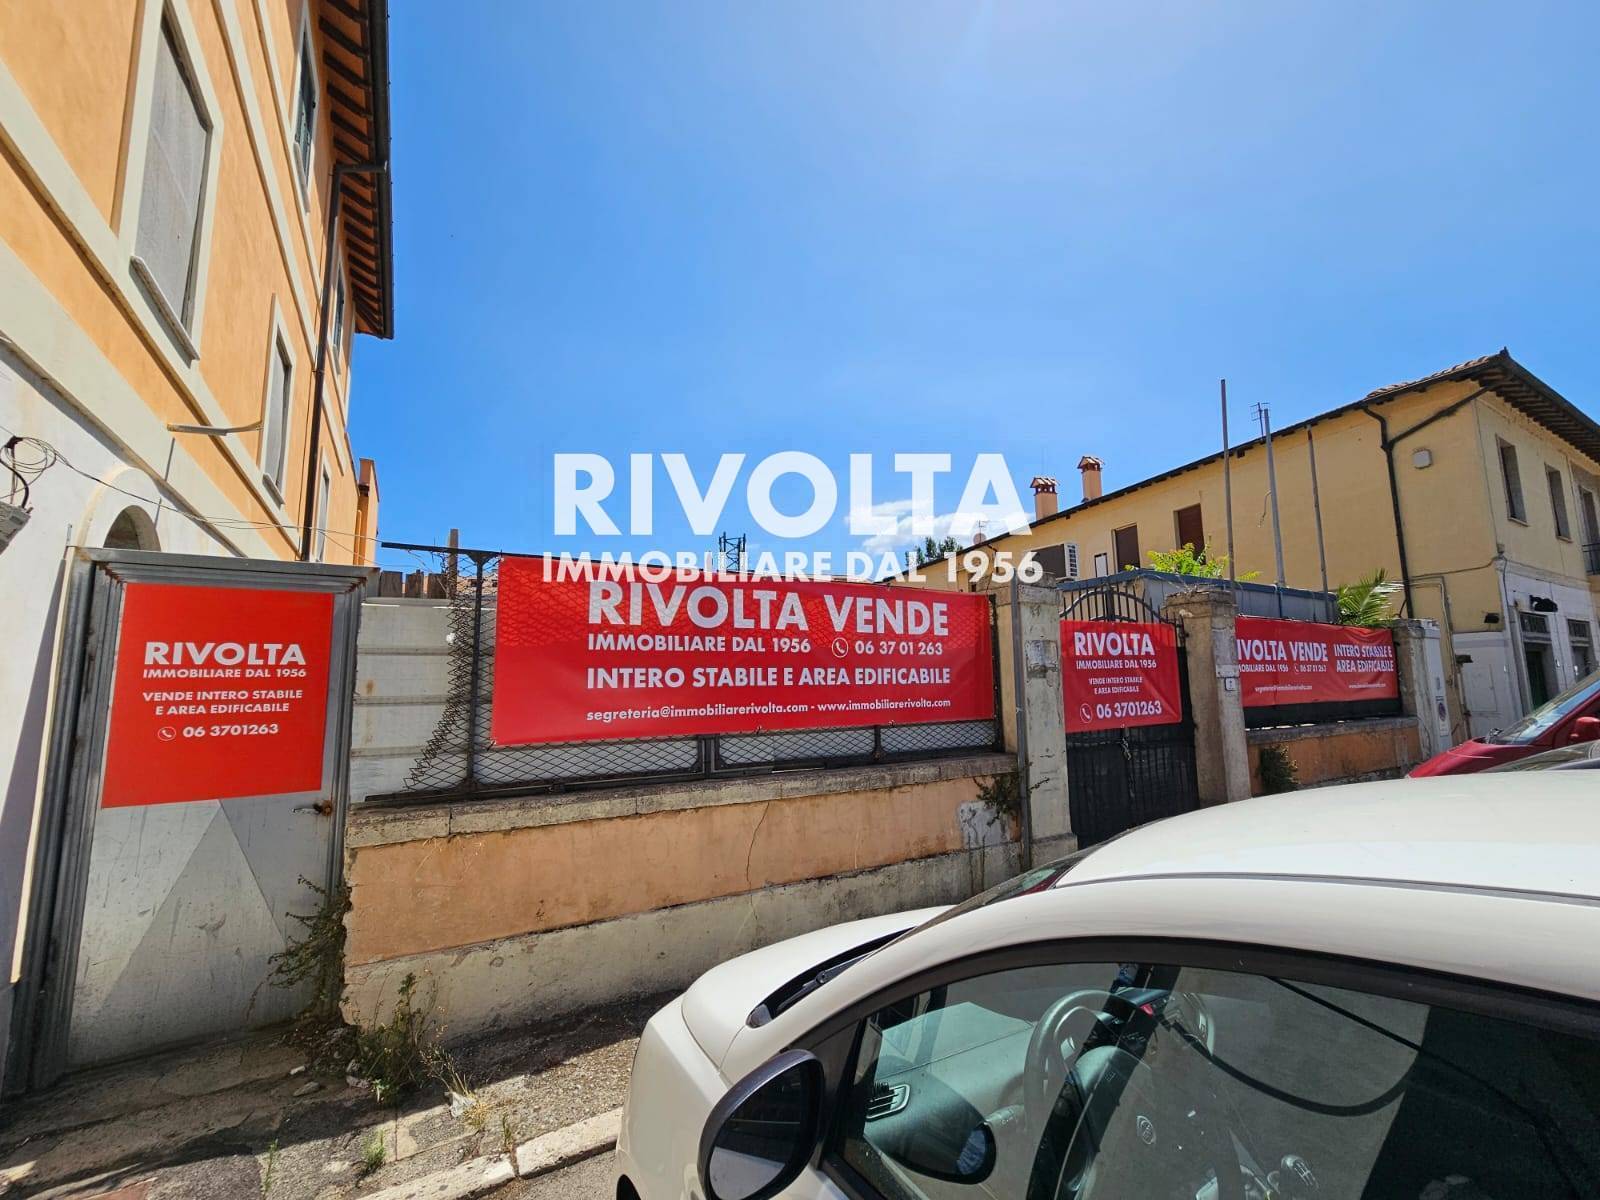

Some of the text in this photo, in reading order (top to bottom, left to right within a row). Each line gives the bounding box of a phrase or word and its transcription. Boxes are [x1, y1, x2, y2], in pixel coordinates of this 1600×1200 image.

[588, 579, 949, 636] RIVOLTA VENDE
[588, 633, 811, 653] IMMOBILIARE DAL 1956
[855, 640, 943, 655] 06 37 01 263
[1074, 632, 1155, 656] RIVOLTA
[1237, 639, 1328, 661] IVOLTA VENDE
[1334, 644, 1360, 657] INTERO
[1388, 646, 1392, 657] E
[144, 642, 306, 665] RIVOLTA
[1076, 660, 1156, 669] IMMOBILIARE DAL 1956
[1239, 664, 1264, 672] OBILIARE
[1337, 660, 1356, 672] AREA
[143, 668, 306, 678] IMMOBILIARE DAL 1956
[587, 667, 951, 689] INTERO STABILE E AREA EDIFICABILE
[143, 690, 303, 701] VENDE INTERO STABILE
[155, 703, 290, 715] E AREA EDIFICABILE
[587, 702, 808, 723] segreteria@immobiliarerivolta.com
[817, 698, 951, 712] www.immobiliarerivolta.com
[1096, 700, 1162, 719] 06 3701263
[183, 724, 279, 737] 06 3701263
